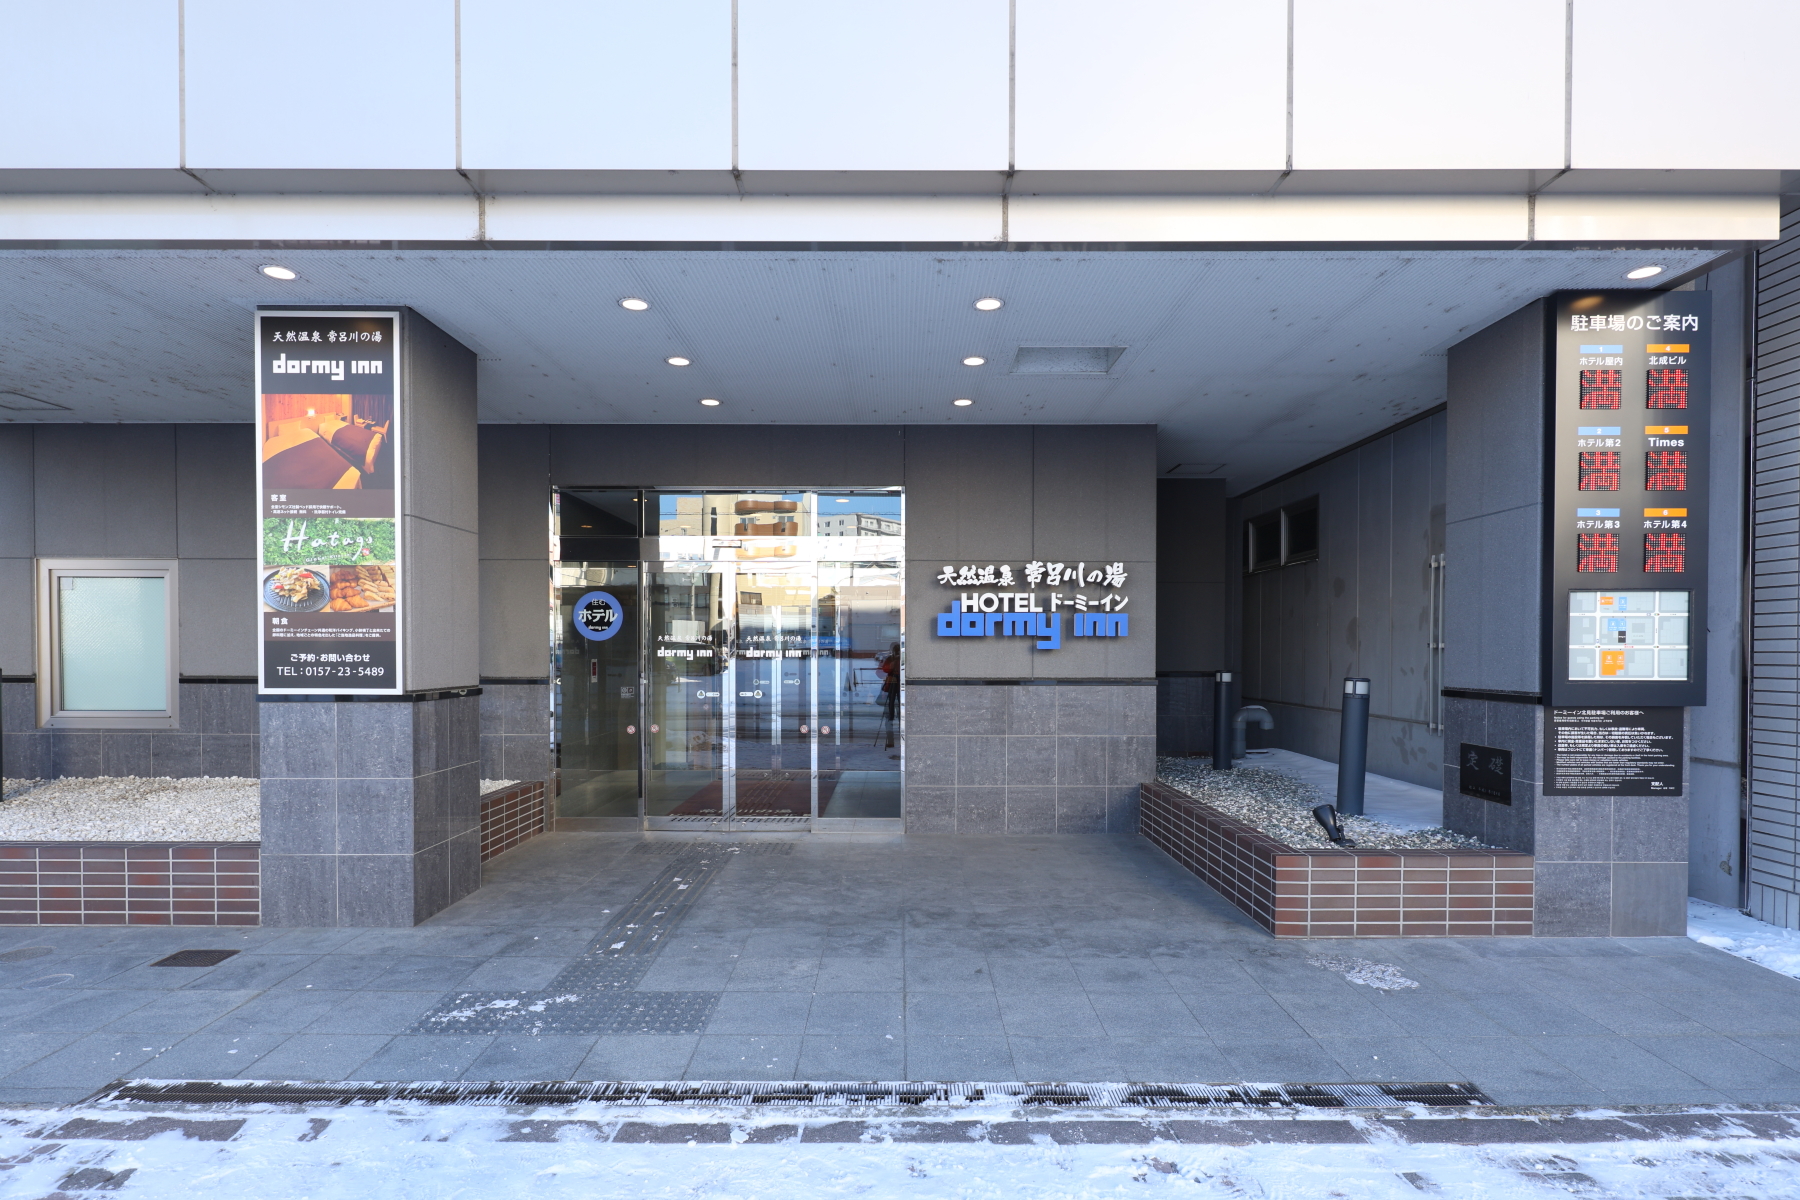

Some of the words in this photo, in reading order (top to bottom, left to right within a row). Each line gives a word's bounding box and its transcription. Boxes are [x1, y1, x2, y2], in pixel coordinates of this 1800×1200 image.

[1570, 314, 1699, 332] 駐車場のご案内
[272, 330, 322, 343] 天然温泉
[327, 329, 382, 343] 常呂川の湯
[272, 353, 344, 380] dormy
[351, 360, 383, 373] inn
[1579, 356, 1623, 366] ホテル屋内
[1648, 355, 1687, 366] 北成ビル
[1582, 370, 1622, 410] 満
[1649, 369, 1689, 409] 満
[1577, 438, 1621, 449] ホテル第2
[1647, 437, 1685, 448] Times
[1581, 451, 1620, 491] 満
[1647, 450, 1687, 490] 満
[1576, 519, 1621, 530] ホテル第3
[1643, 519, 1688, 530] ホテル第4
[280, 519, 373, 561] Hatago
[1579, 533, 1619, 573] 満
[1646, 533, 1686, 572] 満
[937, 564, 1016, 587] 天然温泉
[1024, 560, 1129, 588] 常呂川の湯
[591, 598, 606, 606] 住む
[960, 592, 1044, 613] HOTEL
[1050, 592, 1129, 612] ドーミーイン
[271, 617, 289, 626] 朝食
[578, 608, 618, 623] ホテル
[937, 600, 1061, 650] dormy
[1074, 612, 1129, 637] inn
[290, 653, 371, 663] ご予約・お問い合わせ
[657, 646, 694, 661] dormy
[696, 649, 713, 657] inn
[745, 646, 783, 661] dormy
[785, 649, 802, 658] inn
[1466, 751, 1504, 775] 定礎
